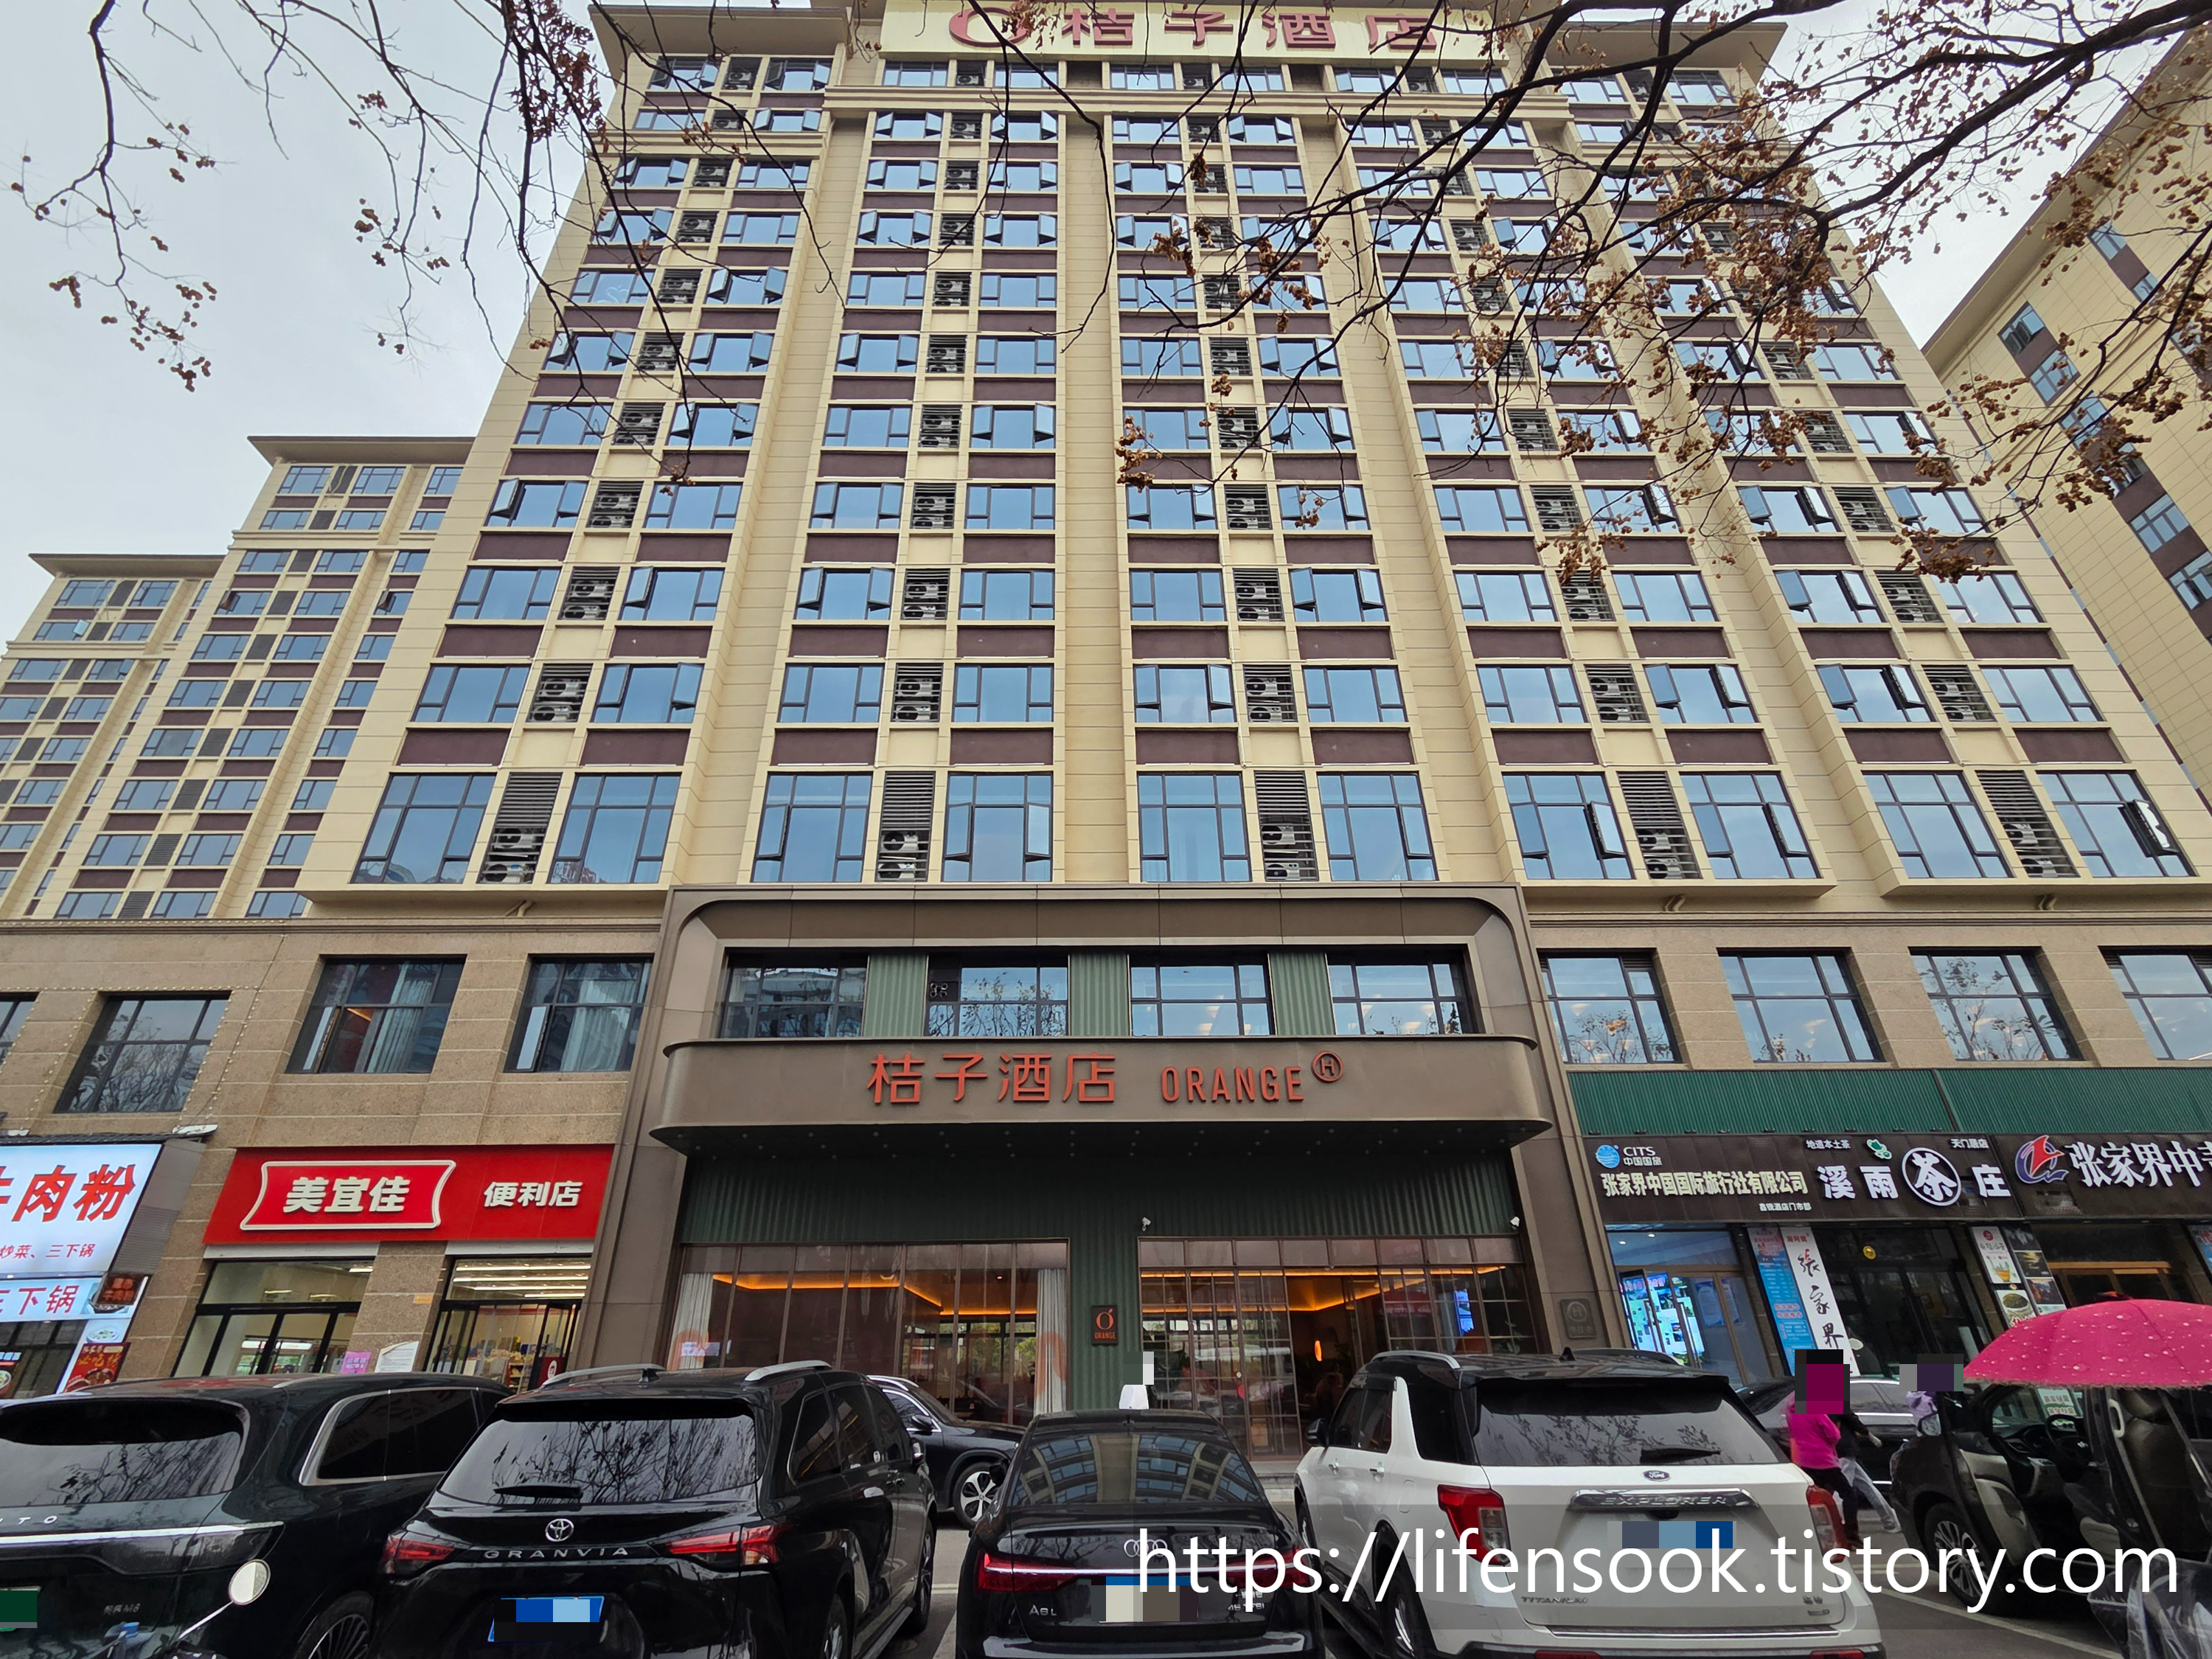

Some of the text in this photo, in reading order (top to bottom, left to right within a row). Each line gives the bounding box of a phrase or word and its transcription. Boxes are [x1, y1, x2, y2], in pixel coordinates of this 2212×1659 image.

[1061, 8, 1436, 50] 桔子酒店
[866, 1052, 1116, 1105] 桔子酒店
[1161, 1065, 1304, 1102] ORANGE
[1623, 1147, 1656, 1156] CITS
[1623, 1157, 1662, 1166] 中国国旅
[282, 1176, 411, 1213] 美宜佳
[484, 1180, 583, 1207] 便利店
[1600, 1171, 1808, 1197] 张家界中国国际旅行社有限公司
[1601, 1495, 1727, 1506] EXPLORER
[484, 1548, 628, 1559] GRANVIA
[1521, 1596, 1588, 1604] TITANIUM
